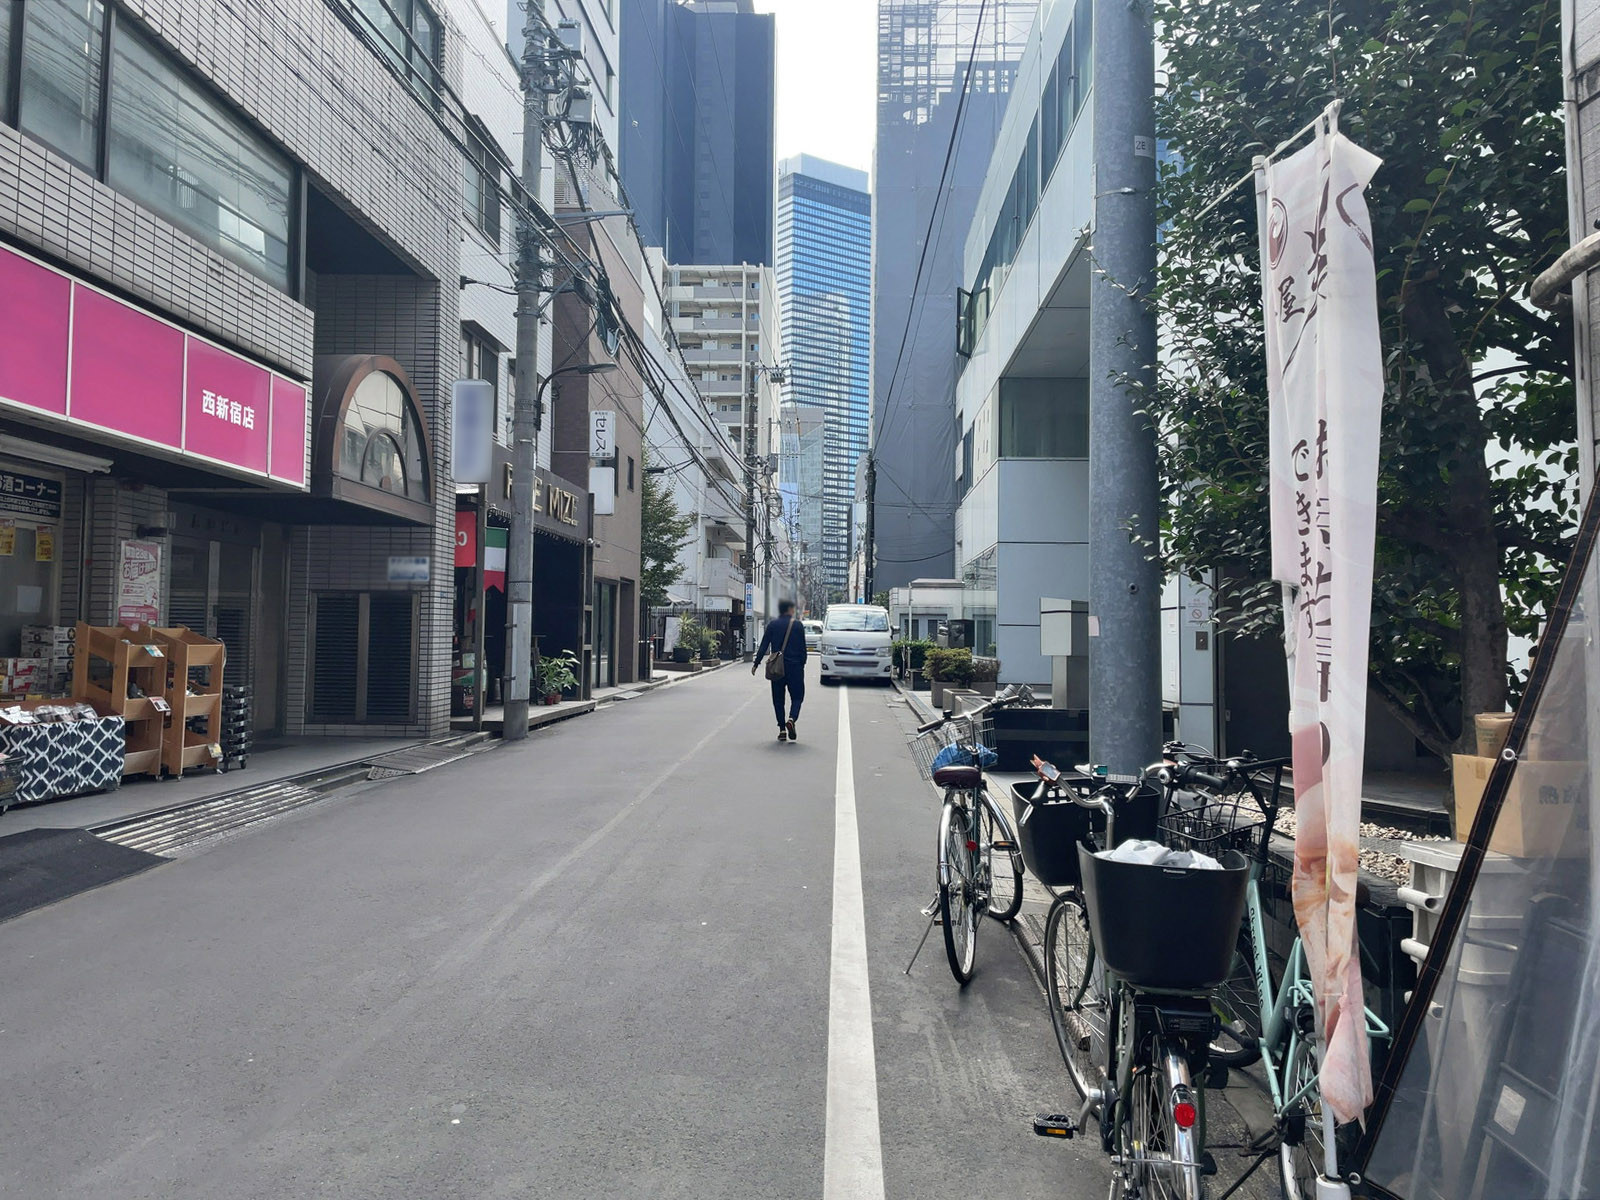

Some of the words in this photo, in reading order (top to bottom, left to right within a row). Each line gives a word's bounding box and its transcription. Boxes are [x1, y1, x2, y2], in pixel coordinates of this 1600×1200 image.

[202, 389, 255, 430] 西新宿店
[595, 415, 607, 451] セレス
[0, 474, 57, 497] 酒コーナー
[1291, 439, 1314, 638] できます
